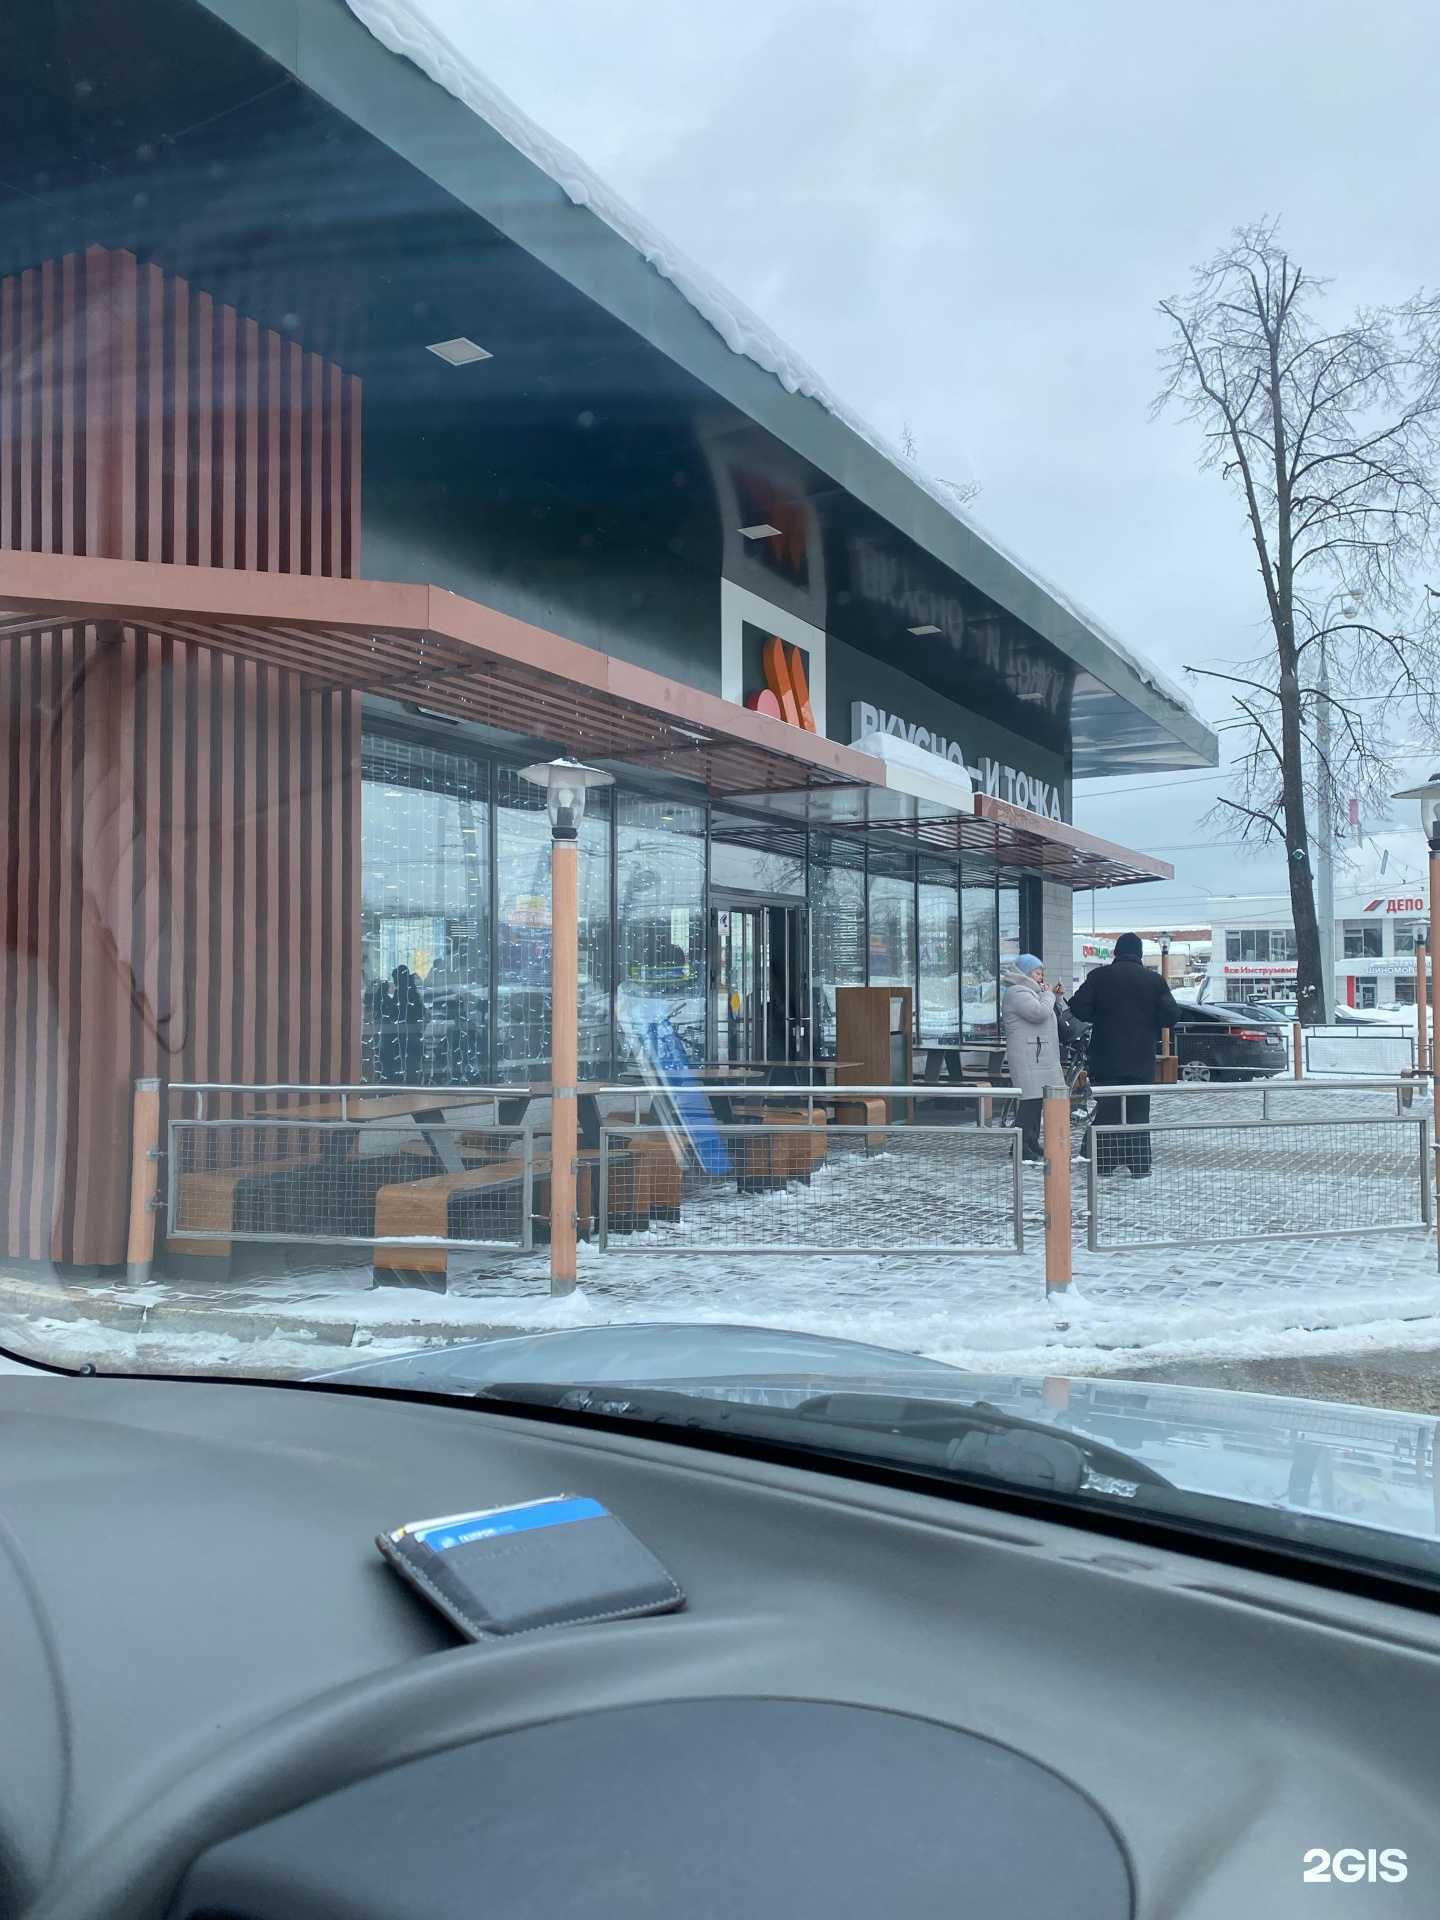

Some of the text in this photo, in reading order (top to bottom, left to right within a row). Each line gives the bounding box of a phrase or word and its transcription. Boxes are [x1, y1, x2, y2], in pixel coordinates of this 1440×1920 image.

[979, 757, 1000, 798] И
[1001, 765, 1062, 822] ТОЧКА
[1386, 898, 1424, 913] ДЕПО
